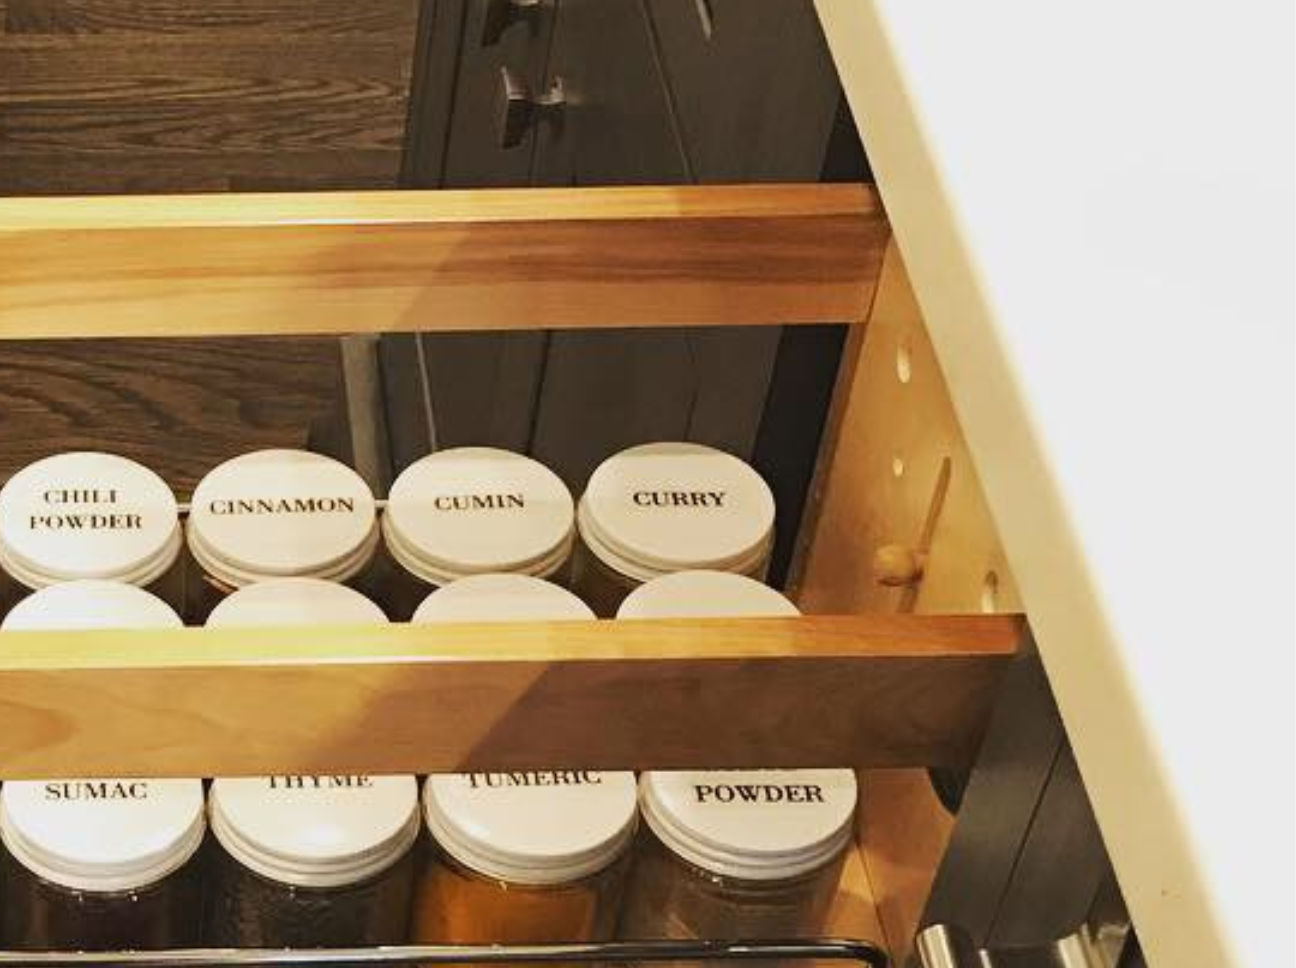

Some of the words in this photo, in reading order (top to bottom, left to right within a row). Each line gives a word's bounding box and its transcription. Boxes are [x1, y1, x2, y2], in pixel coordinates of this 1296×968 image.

[43, 488, 119, 504] CHILI
[434, 492, 526, 512] CUMIN
[633, 490, 727, 508] CURRY
[209, 496, 355, 516] CINNAMON
[29, 513, 144, 531] POWDER
[462, 771, 602, 789] TUMERIC
[45, 782, 148, 801] SUMAC
[694, 784, 826, 803] POWDER
